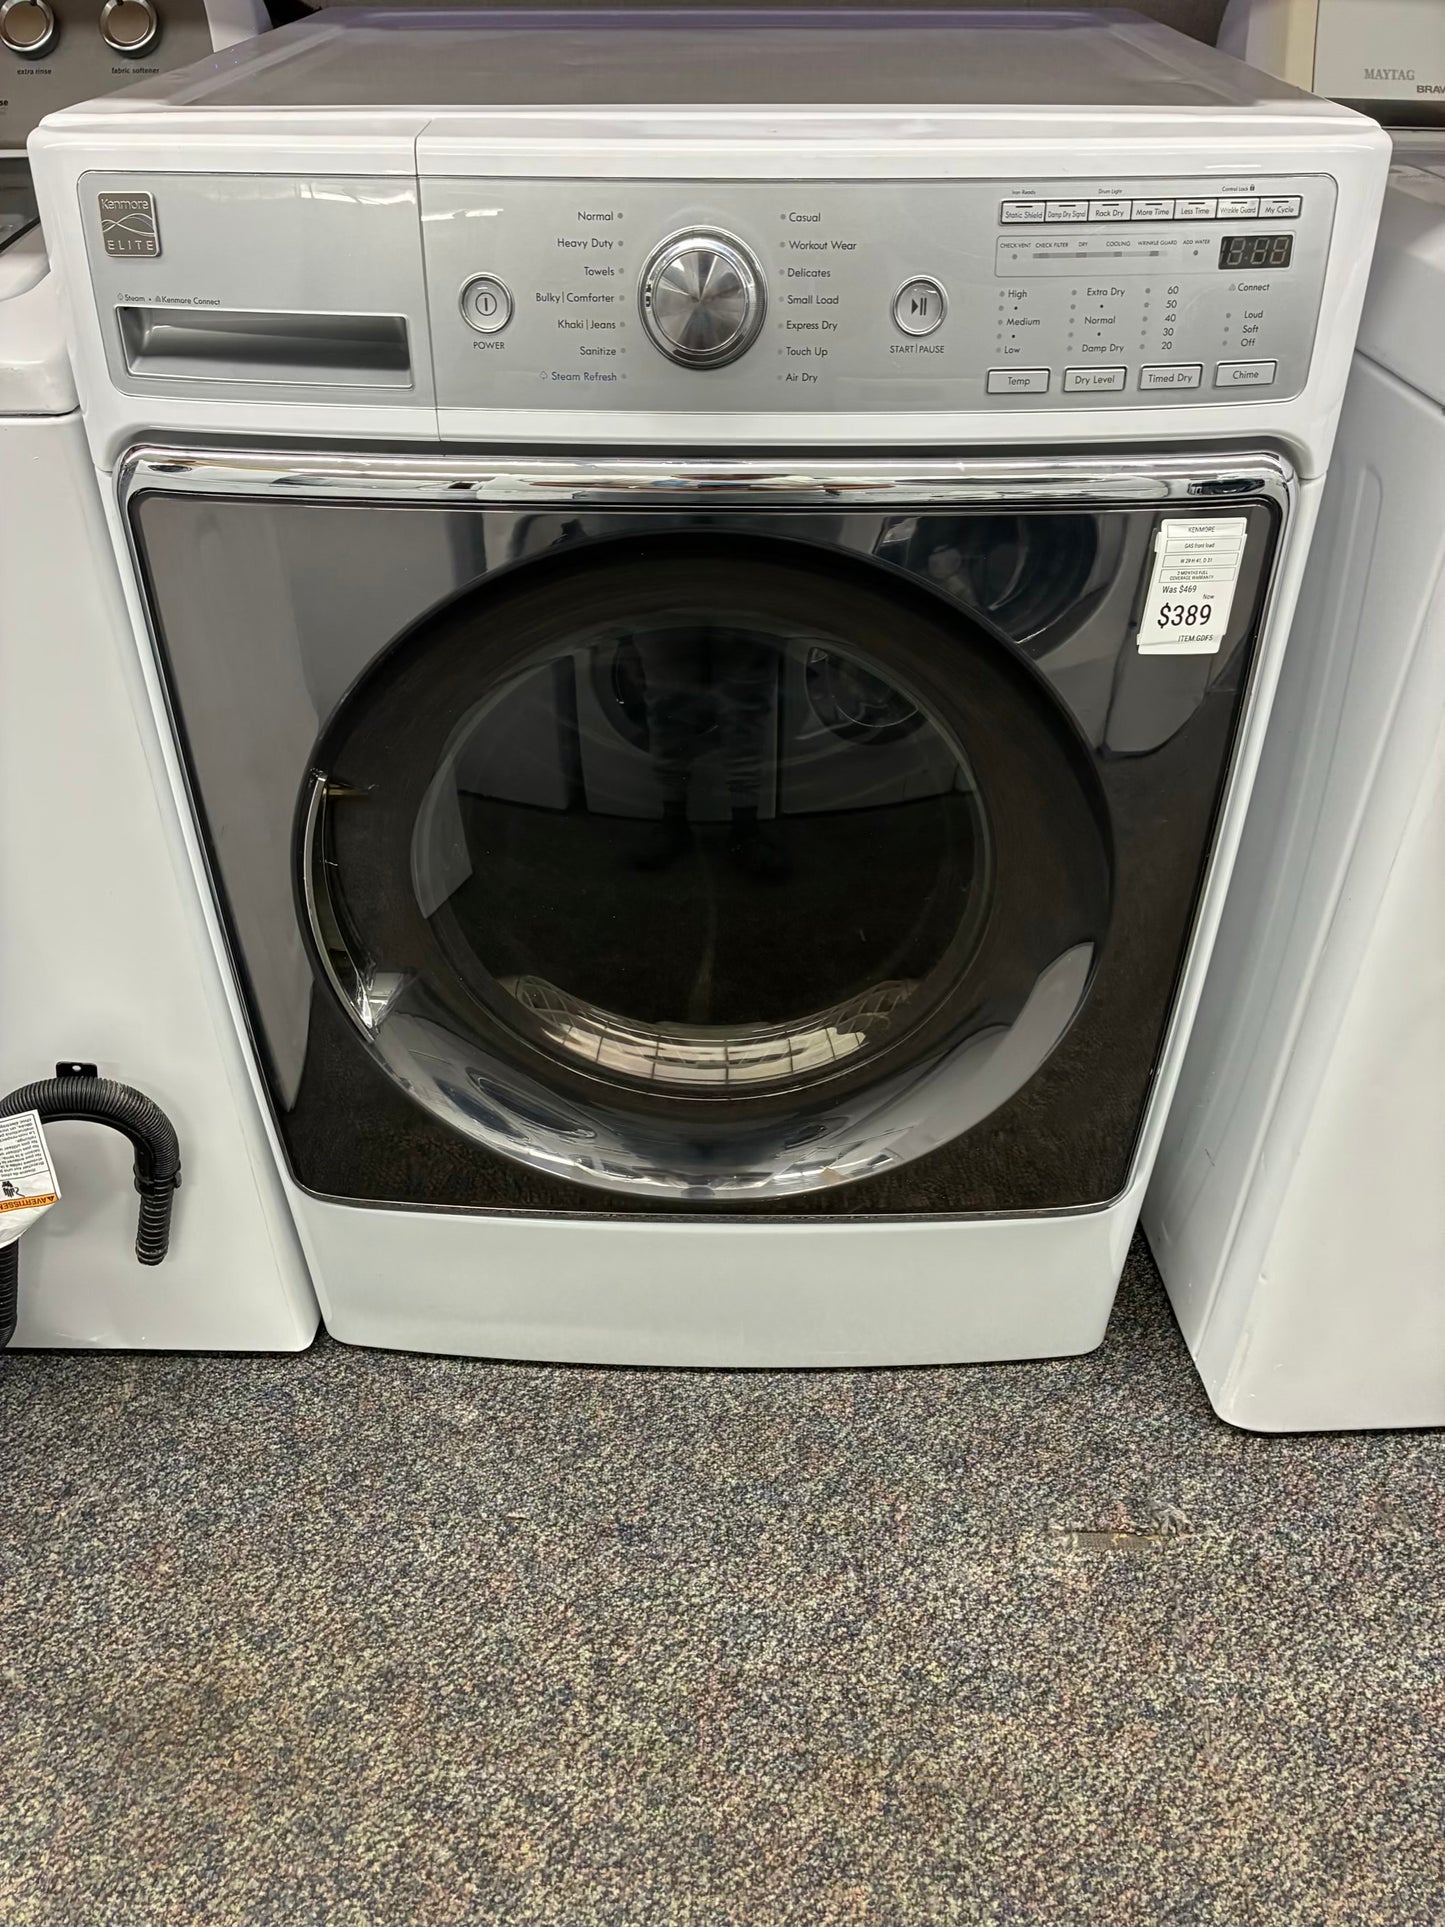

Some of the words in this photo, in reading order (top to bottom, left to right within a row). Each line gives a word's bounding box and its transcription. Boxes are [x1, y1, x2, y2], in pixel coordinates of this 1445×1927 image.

[111, 67, 130, 75] fabric
[132, 67, 160, 75] softener
[1363, 68, 1415, 81] MAYTAG
[101, 198, 149, 210] Kenmore
[1005, 210, 1023, 219] Static
[1024, 210, 1043, 219] Shield
[1047, 211, 1062, 219] Damp
[1062, 211, 1072, 219] Dry
[1095, 209, 1111, 217] Rack
[1112, 209, 1124, 218] Dry
[1136, 208, 1153, 216] More
[1154, 208, 1170, 216] Time
[1180, 207, 1195, 215] Less
[1195, 207, 1210, 215] Time
[1239, 206, 1256, 214] Guard
[1264, 206, 1275, 215] My
[1276, 206, 1295, 214] Cycle
[577, 211, 614, 221] Normal
[788, 211, 821, 222] Casual
[107, 240, 154, 251] ELITE
[557, 237, 588, 249] Heavy
[591, 237, 614, 249] Duty
[788, 240, 828, 250] Workout
[830, 240, 857, 250] Wear
[584, 266, 615, 276] Towels
[787, 267, 831, 278] Delicates
[1167, 285, 1180, 295] 60
[1237, 282, 1270, 292] Connect
[1007, 289, 1028, 300] High
[1086, 287, 1108, 297] Extra
[1110, 287, 1126, 298] Dry
[124, 294, 146, 302] Steam
[161, 296, 192, 305] Kenmore
[193, 297, 221, 305] Connect
[787, 294, 813, 305] Small
[816, 294, 839, 305] Load
[1165, 299, 1178, 309] 50
[1164, 313, 1177, 323] 40
[1244, 310, 1264, 319] Loud
[1006, 318, 1041, 326] Medium
[1084, 316, 1116, 325] Normal
[786, 320, 819, 332] Express
[821, 320, 838, 332] Dry
[1242, 324, 1259, 334] Soft
[1162, 327, 1175, 337] 30
[473, 341, 505, 350] POWER
[1161, 341, 1173, 350] 20
[1240, 338, 1256, 347] Off
[579, 346, 617, 356] Sanitize
[786, 346, 812, 356] Touch
[814, 346, 828, 358] Up
[1004, 345, 1021, 354] Low
[1081, 344, 1107, 354] Damp
[1109, 343, 1125, 353] Dry
[551, 371, 580, 381] Steam
[583, 371, 617, 381] Refresh
[785, 373, 799, 382] Air
[801, 373, 818, 383] Dry
[1148, 373, 1175, 383] Timed
[1177, 373, 1193, 383] Dry
[1232, 370, 1259, 380] Chime
[1008, 376, 1031, 387] Temp
[1074, 375, 1091, 386] Dry
[1093, 375, 1115, 384] Level
[1188, 525, 1216, 533] KENMORE
[1162, 585, 1178, 594] Was
[1178, 585, 1198, 594] $469
[1157, 602, 1212, 629] $389
